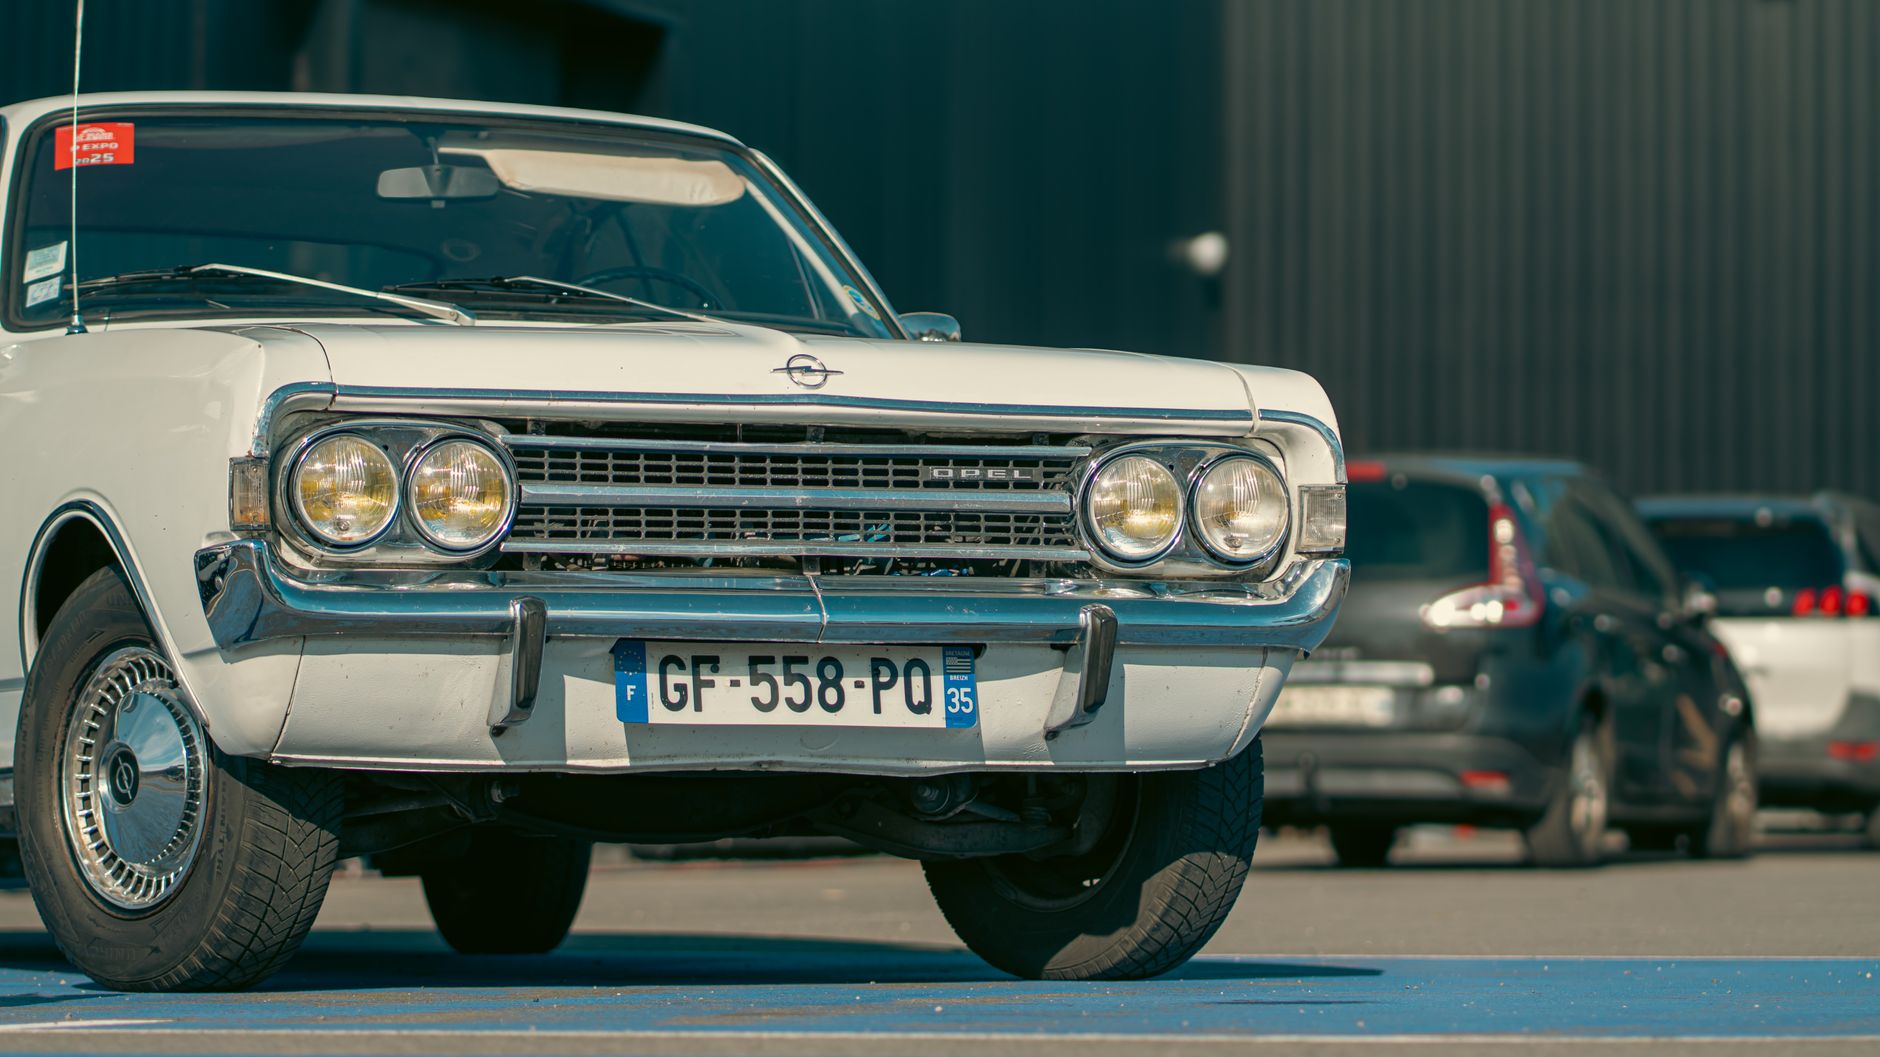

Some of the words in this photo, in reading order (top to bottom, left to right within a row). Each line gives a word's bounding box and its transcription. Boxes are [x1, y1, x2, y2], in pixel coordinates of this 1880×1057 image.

[82, 142, 119, 151] EXPO
[933, 468, 1031, 478] OPEL
[658, 654, 933, 715] GF-558-PQ
[626, 685, 636, 701] F
[946, 687, 973, 714] 35
